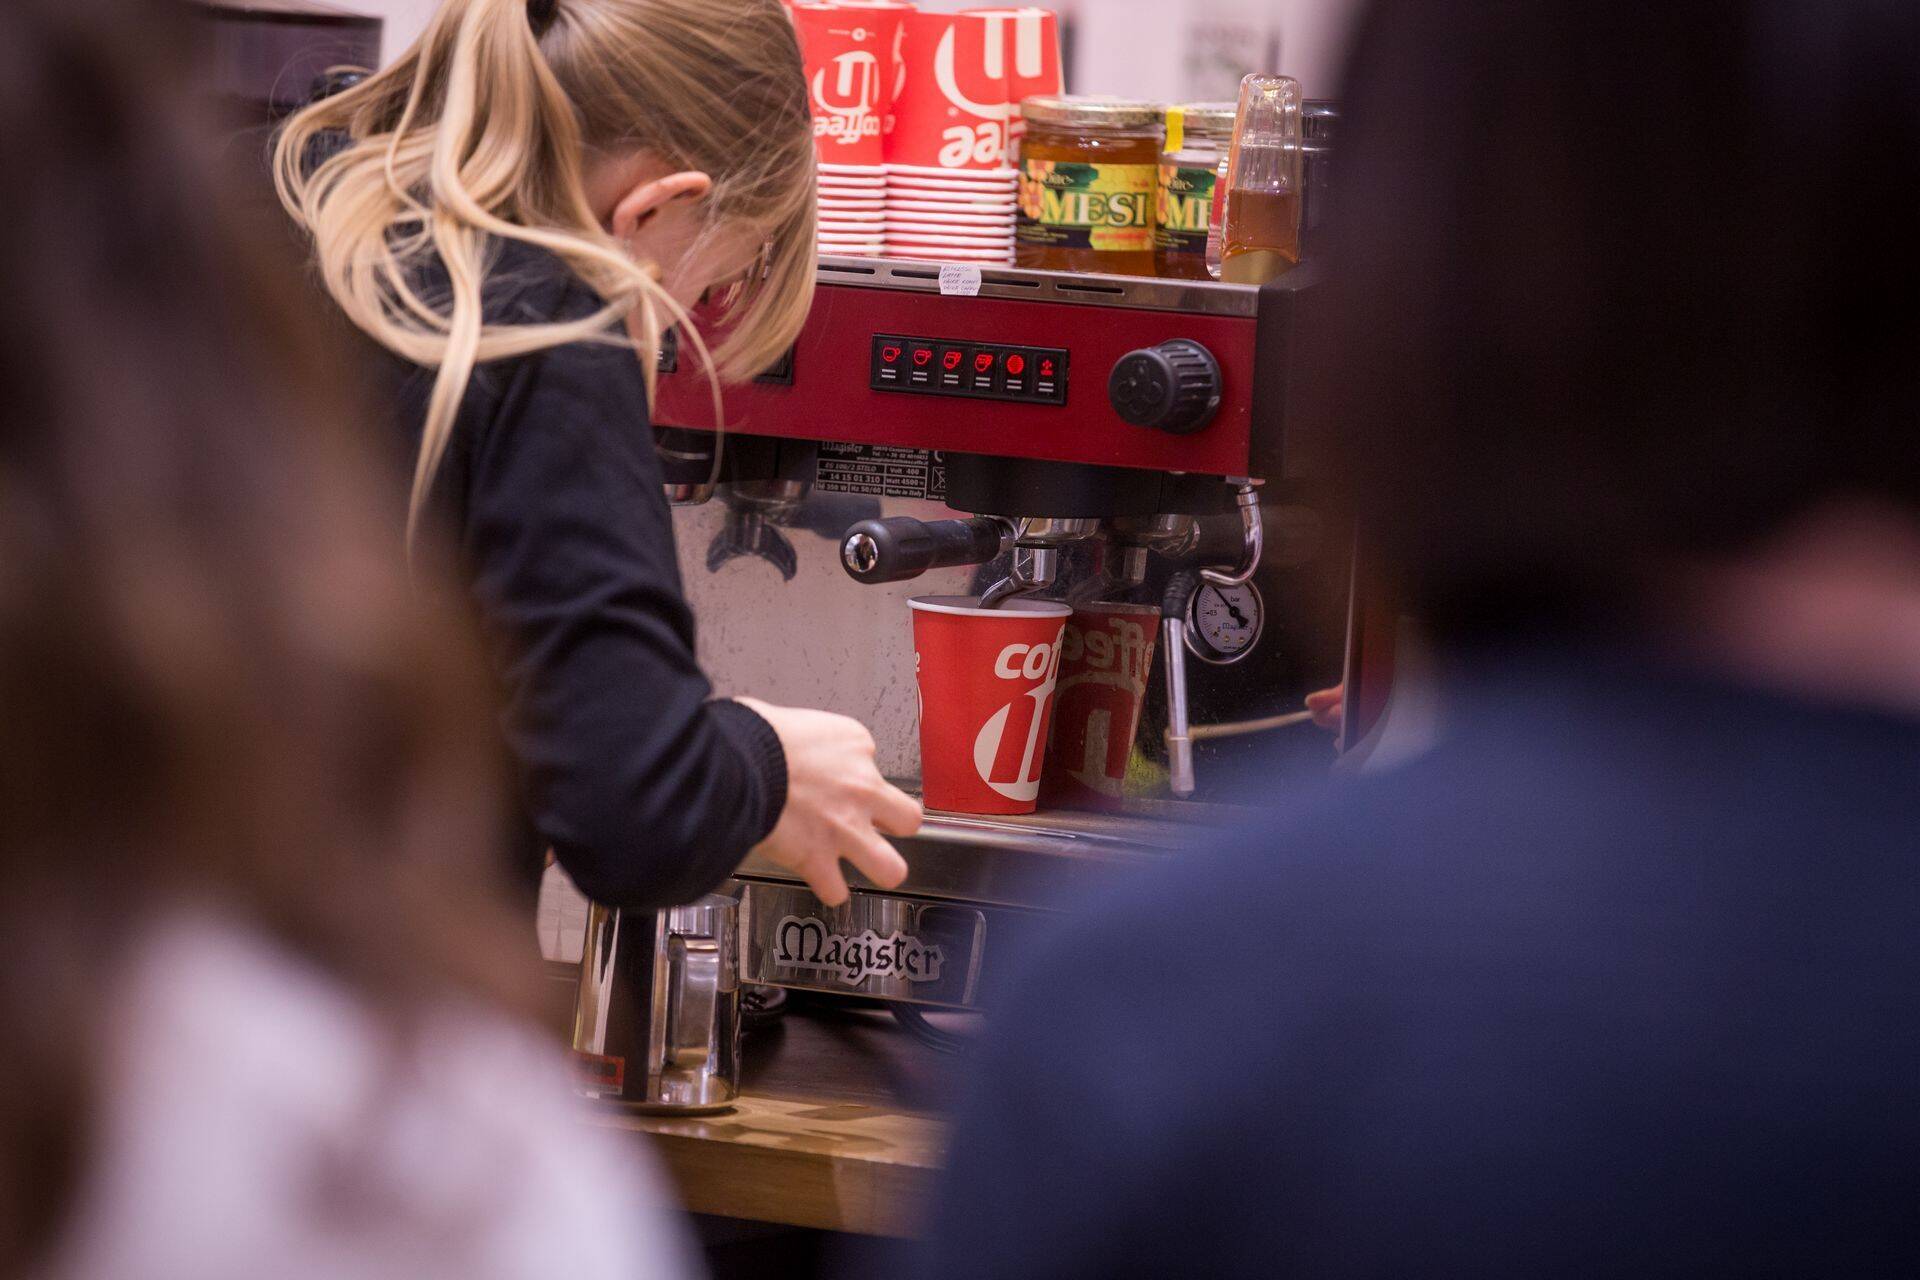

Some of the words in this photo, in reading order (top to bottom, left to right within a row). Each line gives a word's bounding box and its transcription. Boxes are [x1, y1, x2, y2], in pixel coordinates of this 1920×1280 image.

[1039, 191, 1147, 227] MESI
[1164, 194, 1213, 231] ME
[779, 921, 938, 979] Magister
